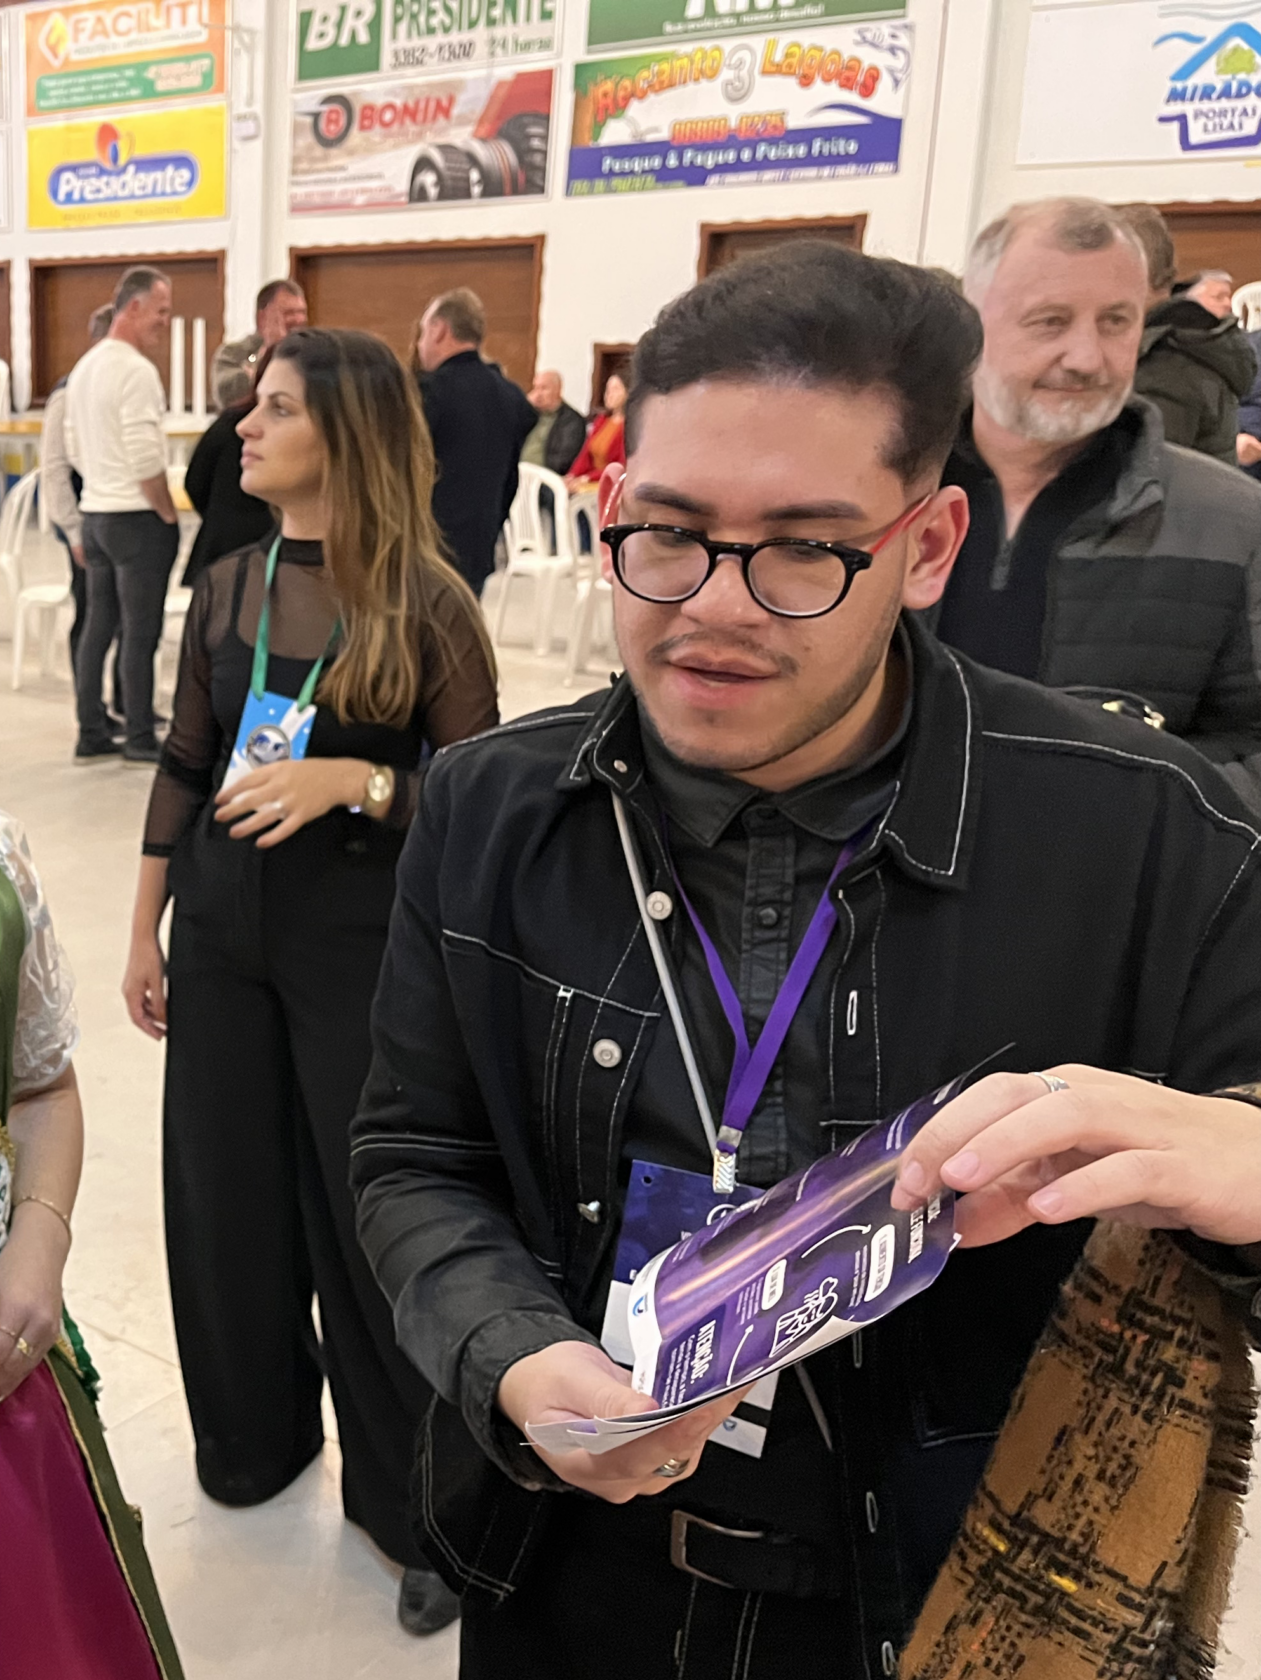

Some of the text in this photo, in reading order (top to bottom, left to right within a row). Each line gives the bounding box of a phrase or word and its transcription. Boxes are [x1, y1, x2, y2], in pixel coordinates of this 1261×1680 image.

[305, 0, 377, 50] BR
[594, 37, 881, 124] Recanto 3 Lagoas
[359, 93, 455, 132] BONIN
[811, 136, 859, 158] Frito
[57, 163, 192, 202] Presidente
[690, 1319, 716, 1384] ATENÇÃO:
